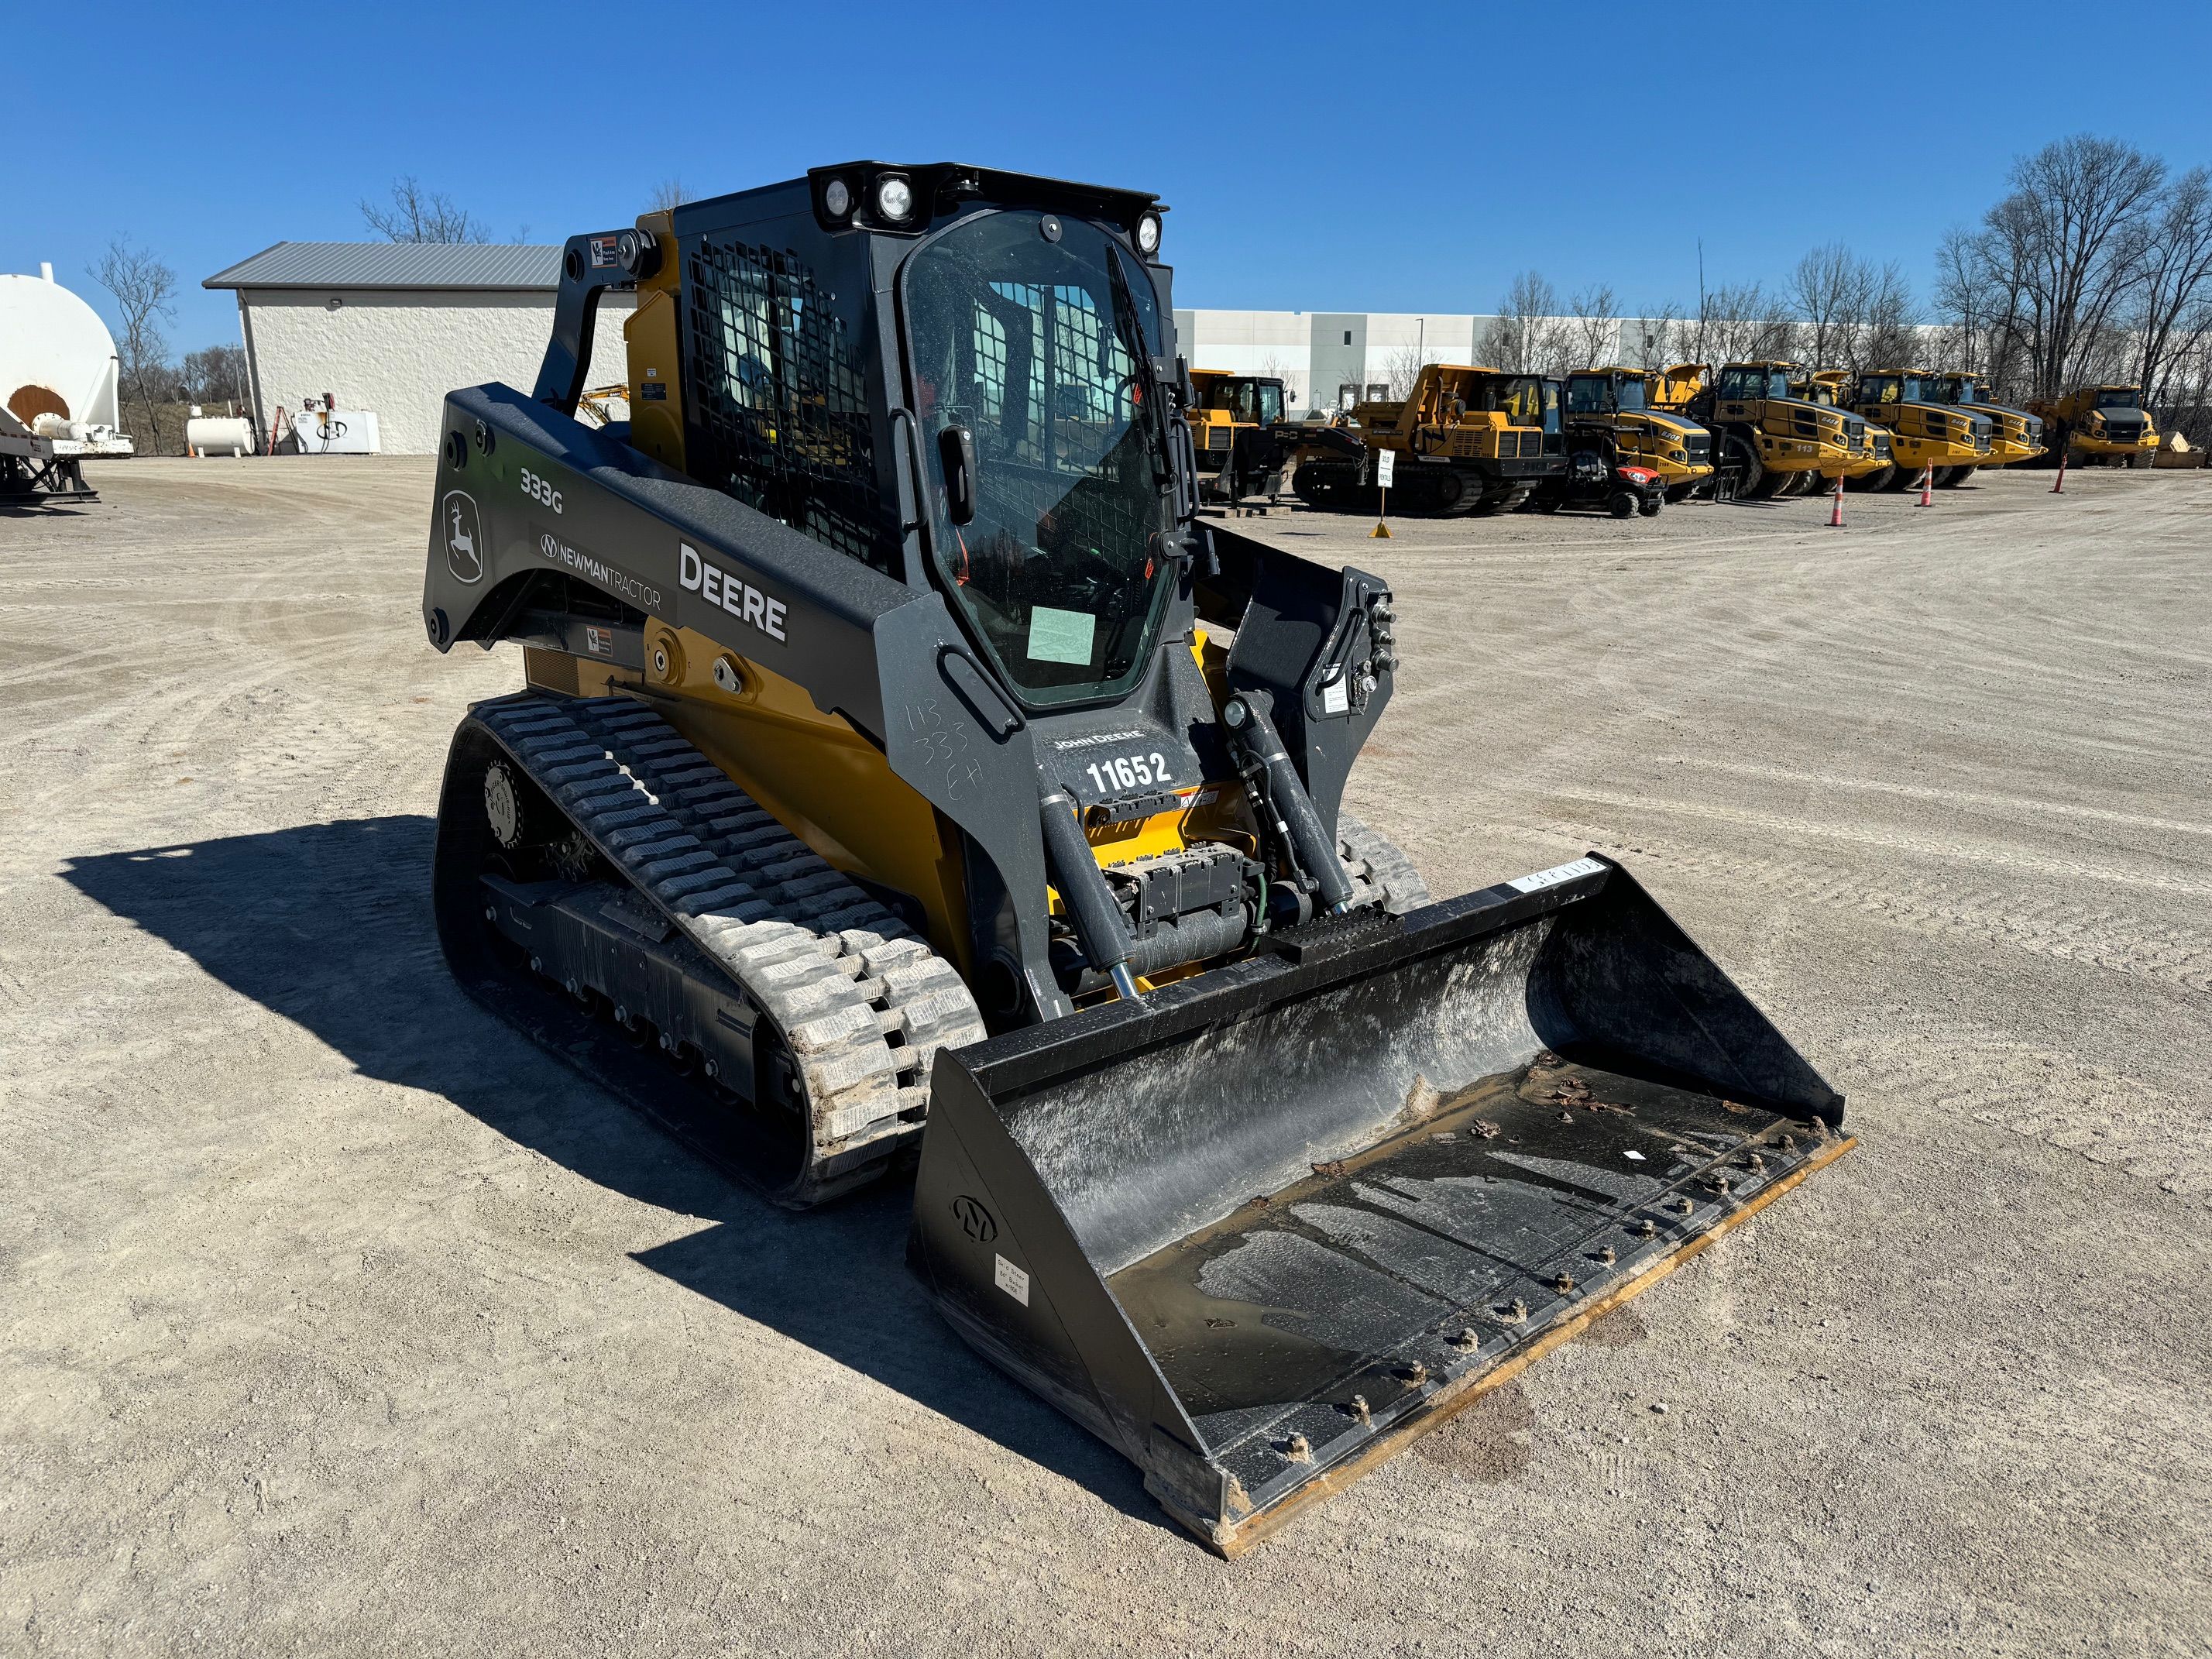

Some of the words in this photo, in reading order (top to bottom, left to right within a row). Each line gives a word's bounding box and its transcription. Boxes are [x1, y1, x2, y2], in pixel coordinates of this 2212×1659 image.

[1796, 445, 1813, 453] 113
[520, 467, 562, 514] 333G
[680, 542, 787, 642] DEERE
[905, 698, 942, 731] 113
[913, 722, 968, 765] 333
[1054, 738, 1094, 750] JOHN
[1094, 730, 1145, 743] DEERE
[1086, 752, 1173, 794] 11652
